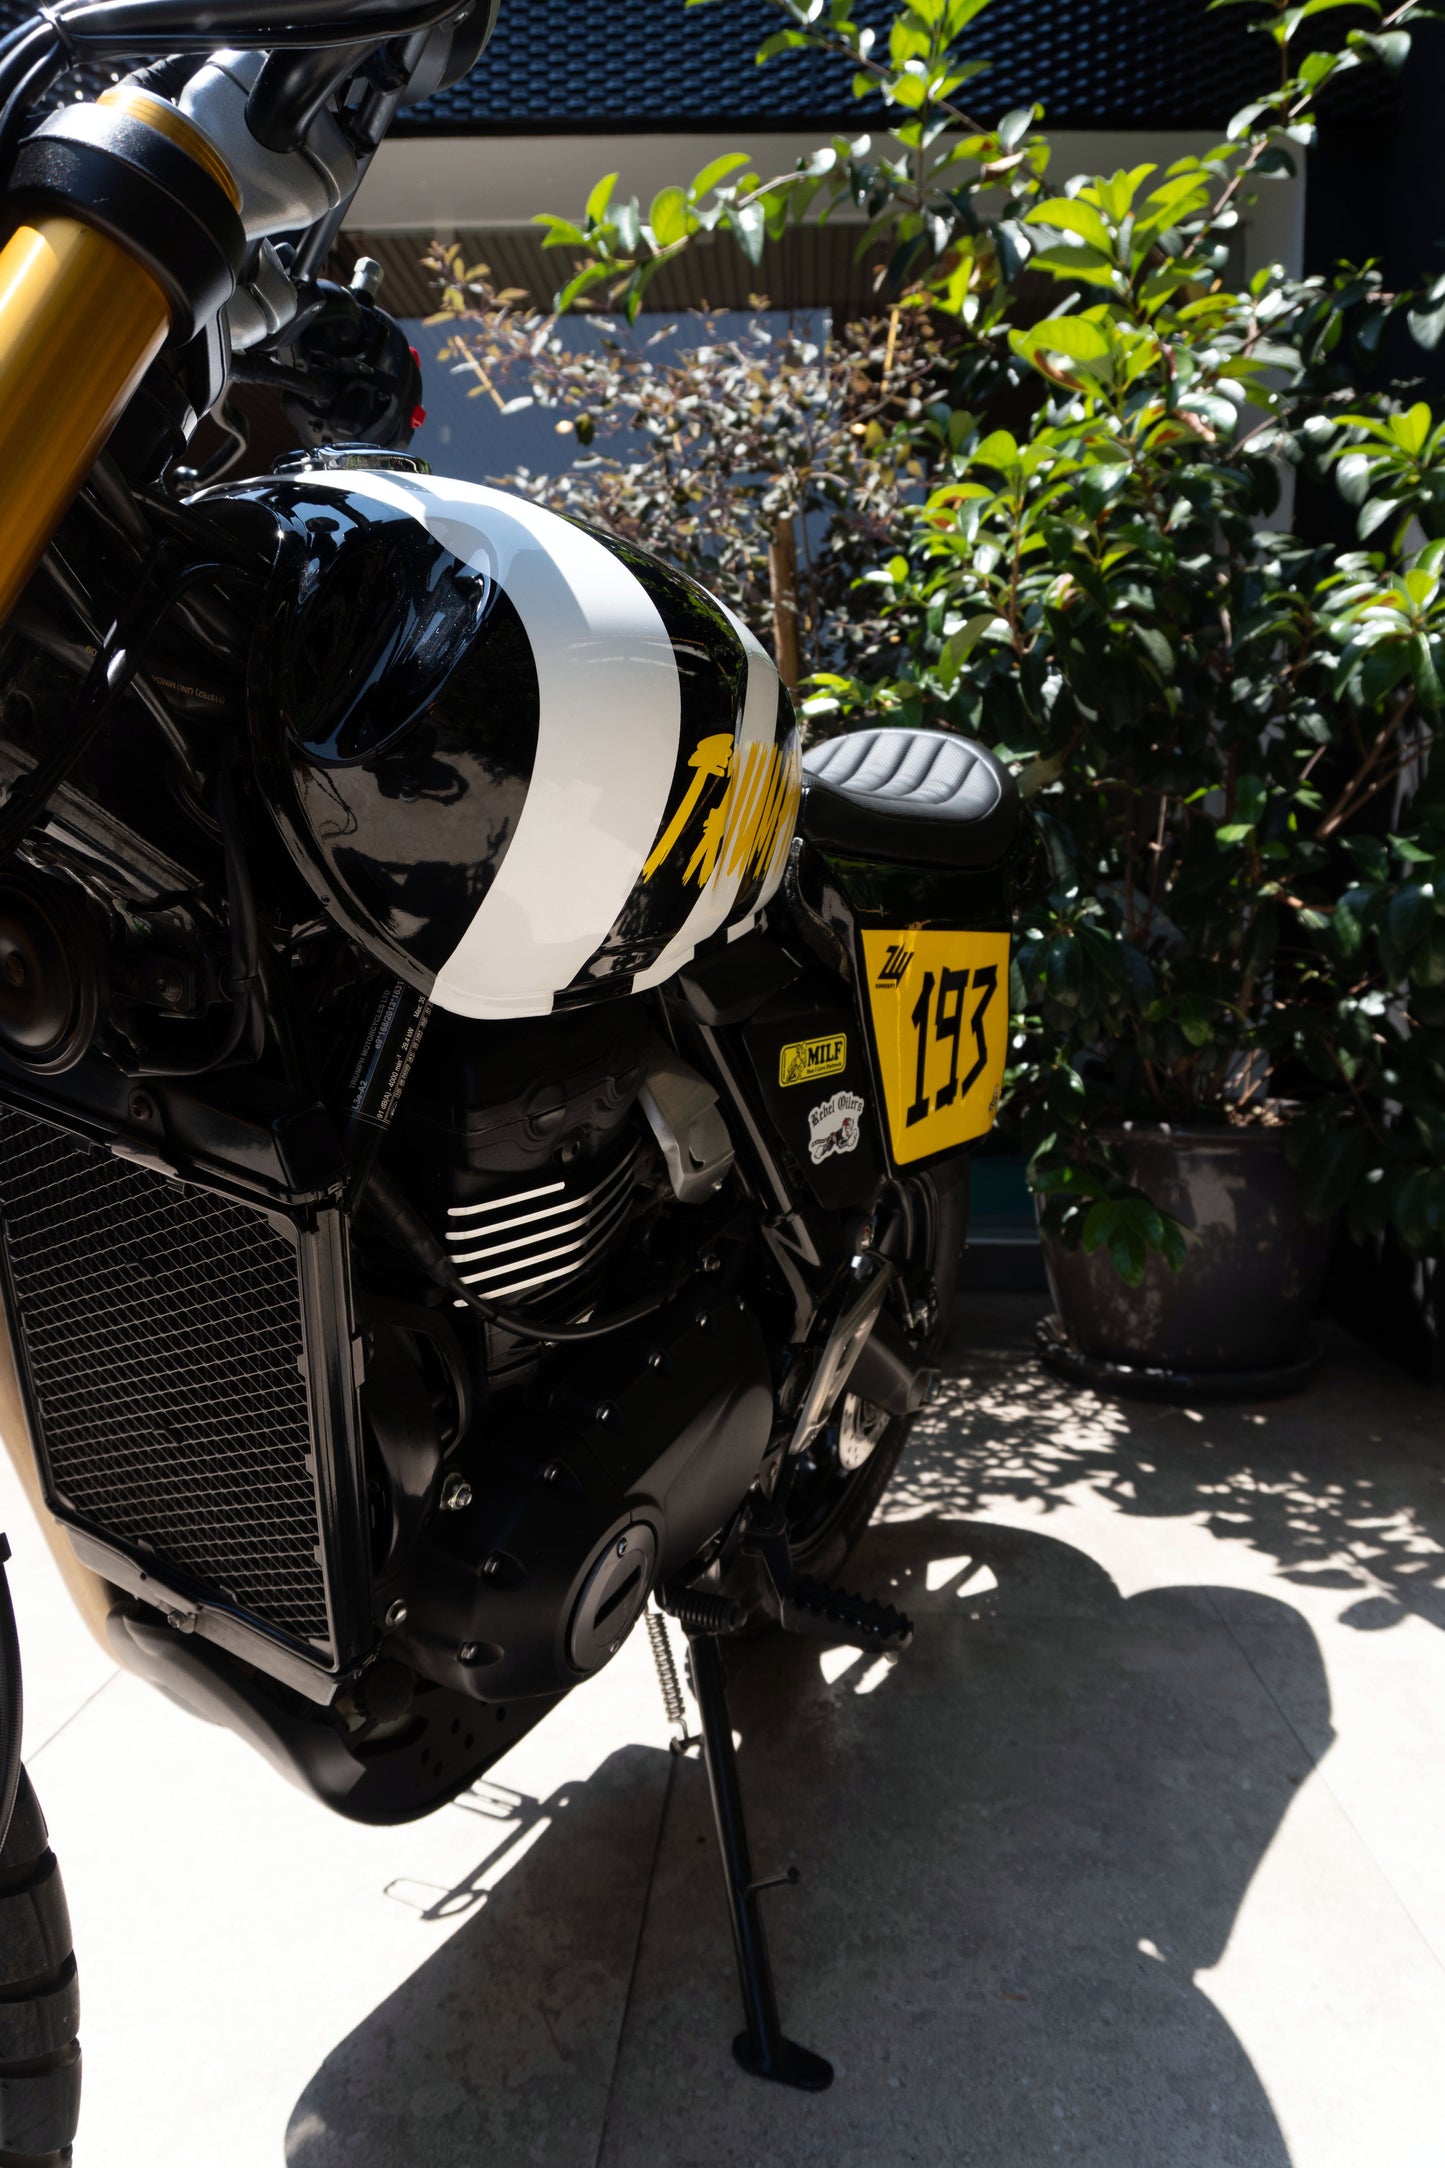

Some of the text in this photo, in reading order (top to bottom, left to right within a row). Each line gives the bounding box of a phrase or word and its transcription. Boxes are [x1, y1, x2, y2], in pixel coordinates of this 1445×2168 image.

[349, 989, 390, 1088] TRIUMPH MOTORCYCLES LTD
[807, 1040, 843, 1067] MILF
[905, 963, 998, 1129] 193
[387, 1070, 399, 1088] 4000
[811, 1094, 863, 1127] Rebel Oilers
